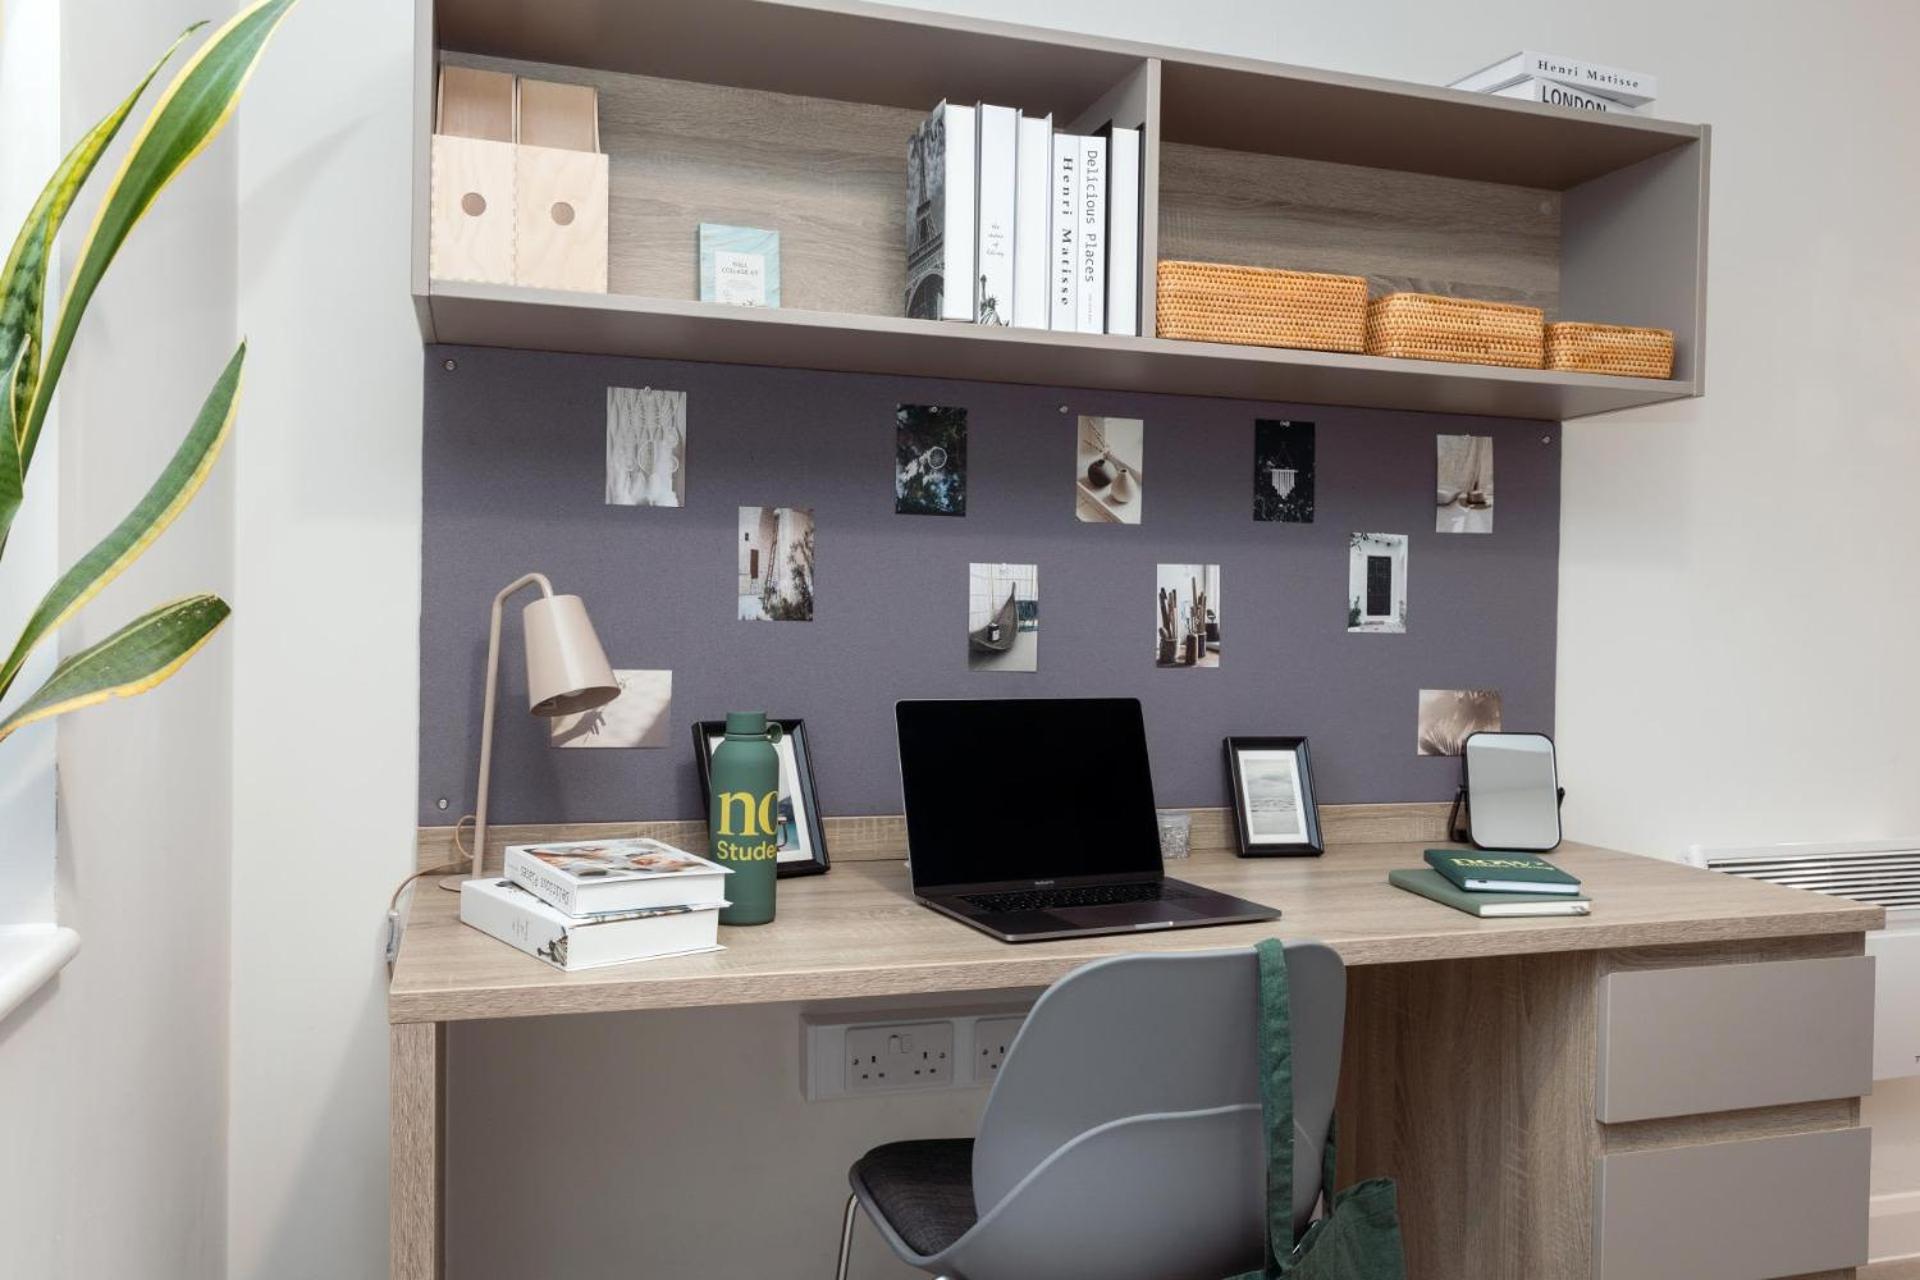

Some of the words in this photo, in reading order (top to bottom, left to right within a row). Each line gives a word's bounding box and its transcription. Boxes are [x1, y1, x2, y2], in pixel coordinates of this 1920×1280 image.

[1538, 60, 1579, 77] Henri
[1586, 69, 1640, 88] Matisse
[1062, 157, 1073, 215] Henri
[1086, 151, 1099, 225] Delicious
[1061, 228, 1072, 306] Matisse
[1085, 232, 1098, 283] Places
